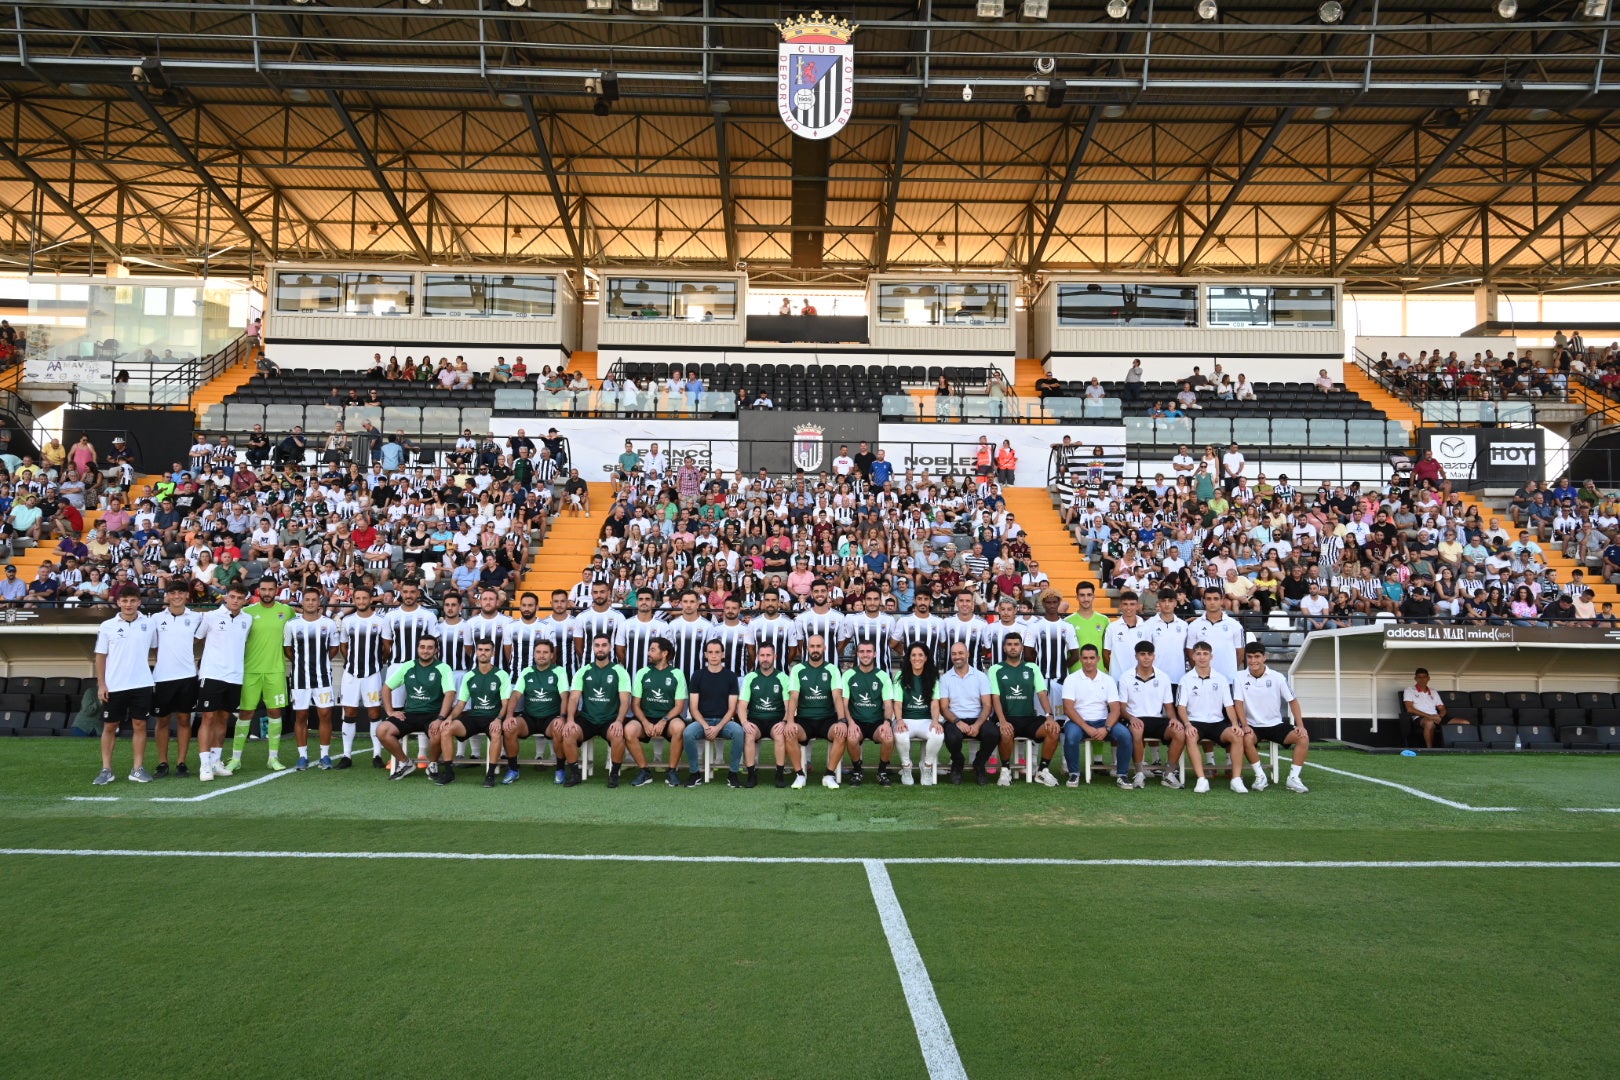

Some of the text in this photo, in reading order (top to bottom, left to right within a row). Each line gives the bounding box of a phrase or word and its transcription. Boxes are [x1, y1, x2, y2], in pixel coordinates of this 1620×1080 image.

[798, 45, 836, 54] CLUB
[779, 55, 799, 131] DEPORTIVO
[837, 56, 853, 125] BADAJOZ
[637, 449, 712, 458] BANCO
[1491, 446, 1534, 461] HOY
[1386, 627, 1426, 639] adidas
[1427, 627, 1440, 640] LA
[1443, 627, 1465, 640] MAR
[274, 693, 285, 705] 13
